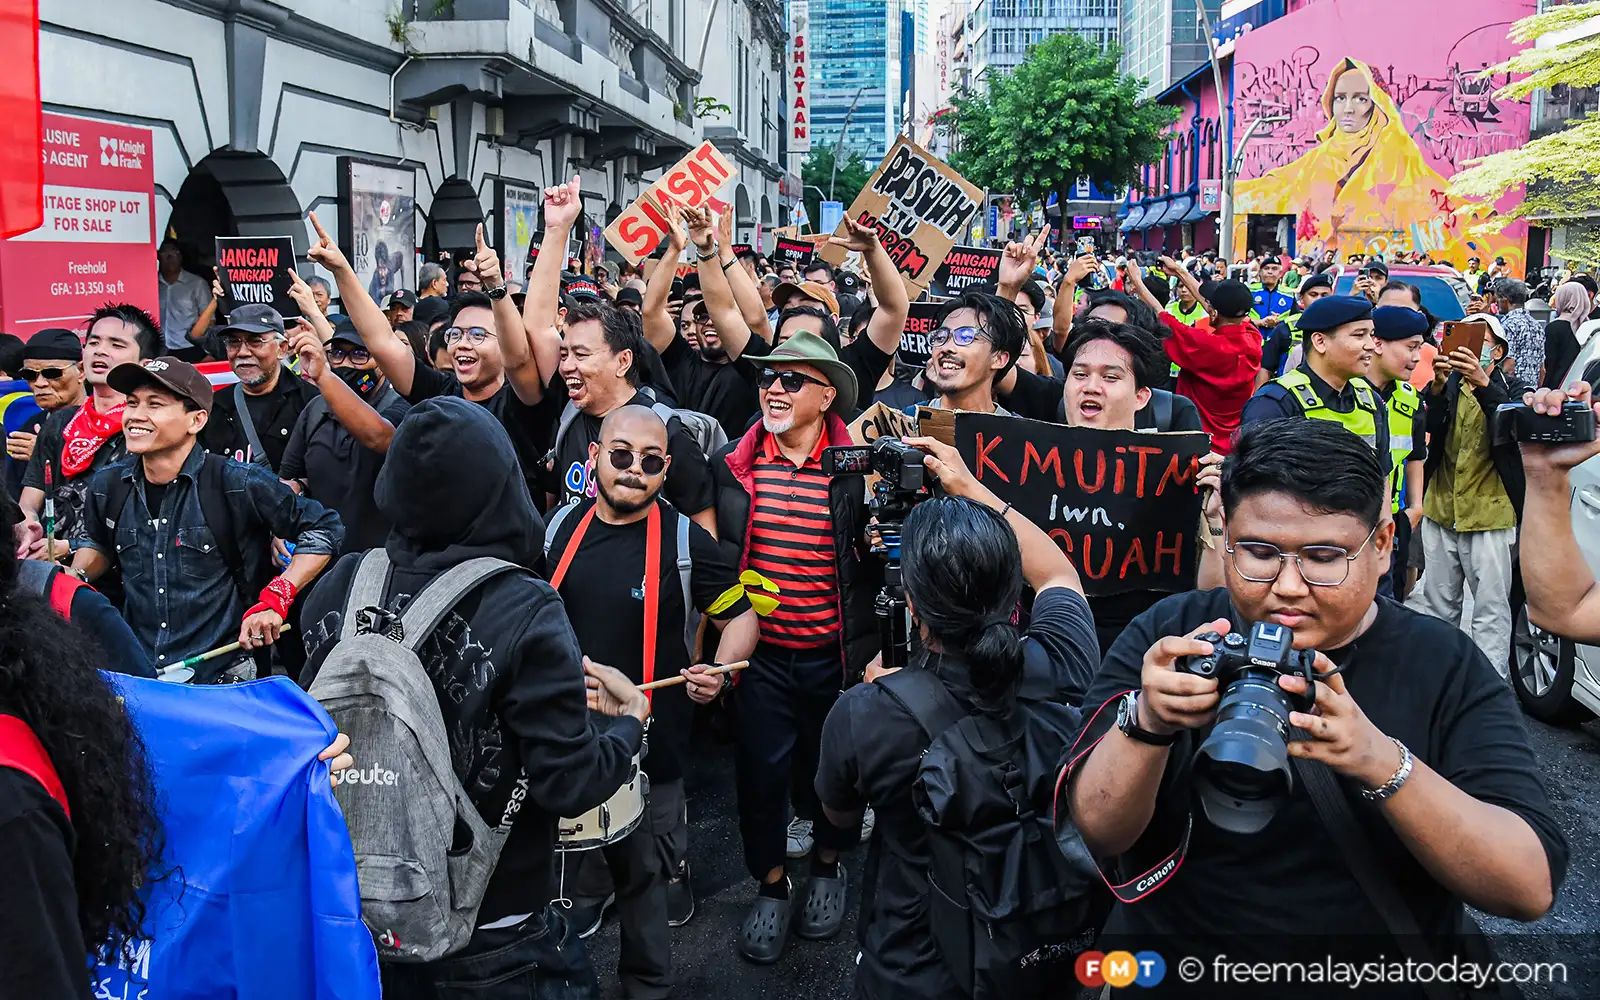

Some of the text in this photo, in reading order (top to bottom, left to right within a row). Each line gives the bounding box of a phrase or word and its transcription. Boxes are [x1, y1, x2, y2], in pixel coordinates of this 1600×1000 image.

[794, 35, 806, 139] SHAYAAN
[119, 139, 146, 156] Knight
[50, 150, 88, 169] AGENT
[120, 154, 142, 169] Frank
[85, 198, 117, 212] SHOP
[120, 201, 140, 214] LOT
[54, 217, 112, 232] FOR SALE
[355, 232, 368, 257] 10
[220, 248, 279, 267] JANGAN
[944, 252, 999, 270] JANGAN
[68, 261, 107, 274] Freehold
[227, 269, 274, 282] TANGKAP
[950, 266, 992, 278] TANGKAP
[51, 280, 124, 296] GFA: 13,350 sq ft
[230, 283, 274, 303] AKTIVIS
[1250, 657, 1277, 668] Canon
[1136, 859, 1176, 892] Canon
